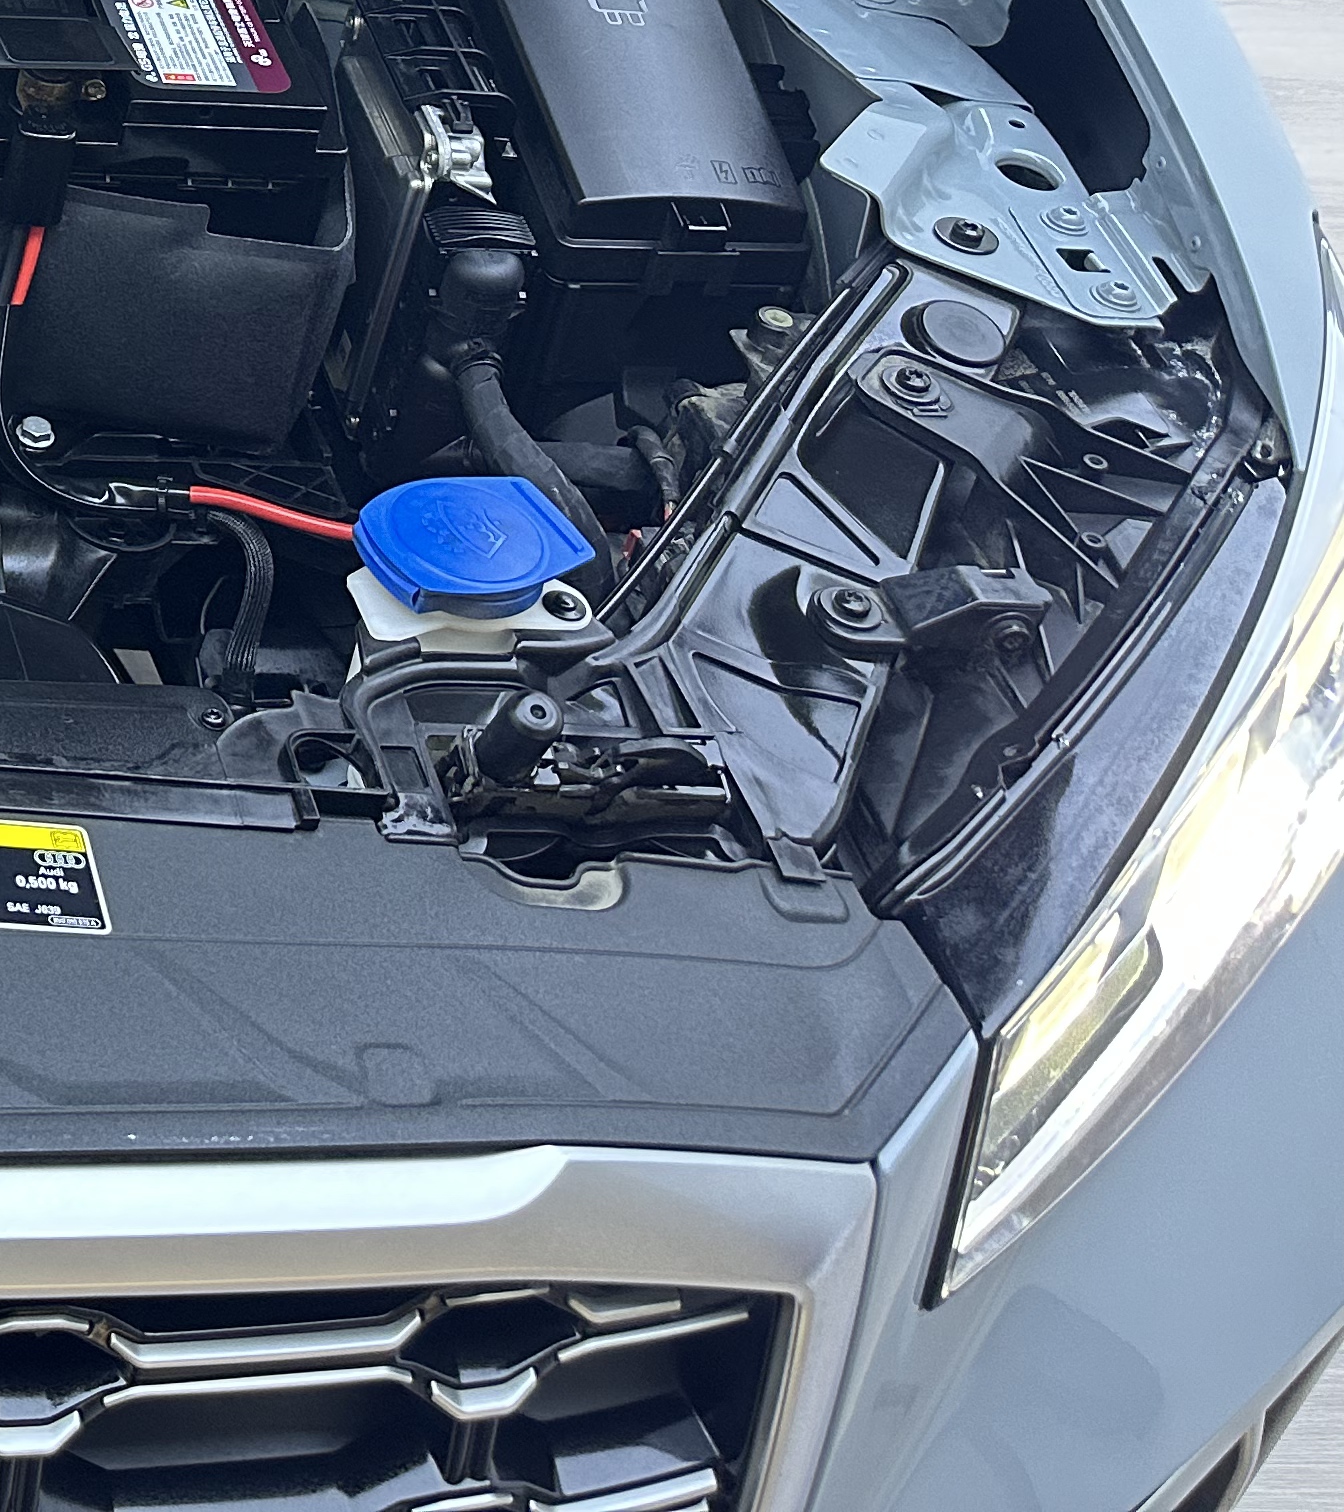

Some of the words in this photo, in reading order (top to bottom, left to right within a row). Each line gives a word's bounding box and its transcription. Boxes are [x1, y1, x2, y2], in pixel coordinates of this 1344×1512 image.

[38, 867, 64, 877] Audi
[15, 874, 56, 892] 0,500
[58, 879, 79, 895] kg
[6, 902, 30, 914] SAE
